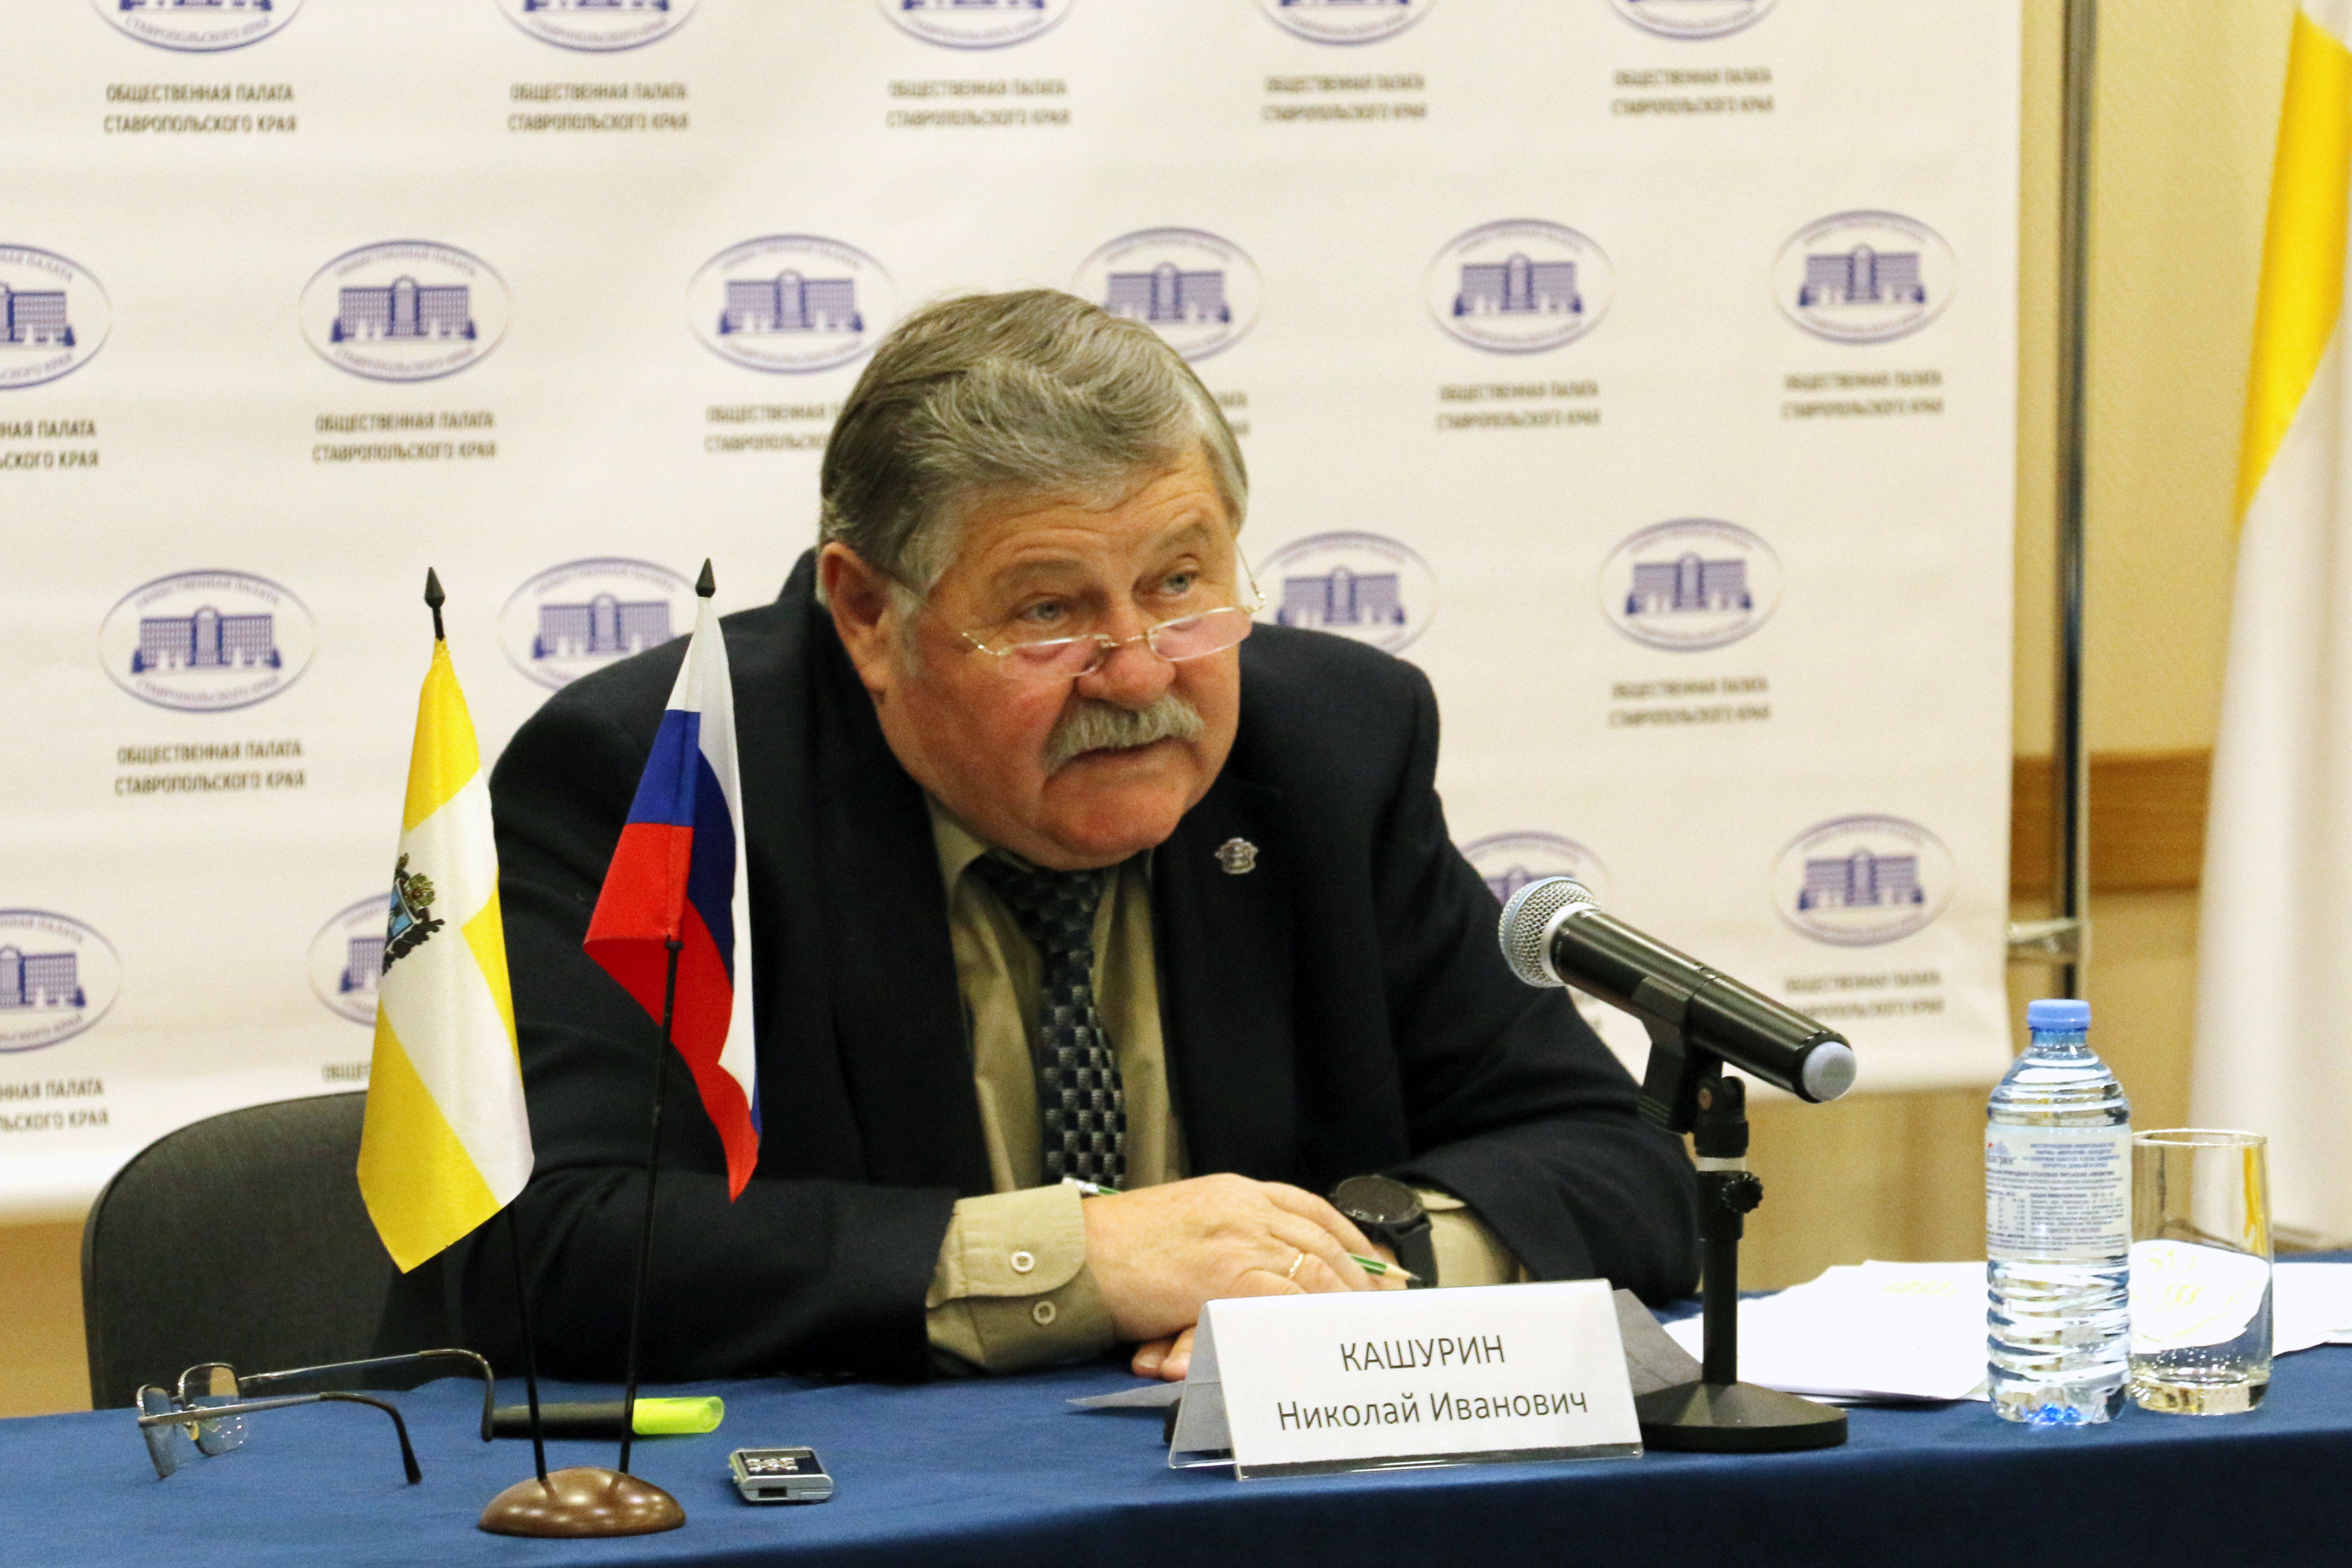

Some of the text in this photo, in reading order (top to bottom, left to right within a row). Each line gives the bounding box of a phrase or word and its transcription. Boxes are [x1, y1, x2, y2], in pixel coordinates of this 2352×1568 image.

[106, 85, 294, 102] ОБЩЕСТВЕННАЯ ПАЛАТА
[510, 82, 688, 102] ОБЩЕСТВЕННАЯ ПАЛАТА
[104, 116, 297, 132] СТАВРОПОЛЬСКОГО КРАЯ
[508, 113, 690, 132] СТАВРОПОЛЬСКОГО КРАЯ
[38, 419, 96, 438] ПАЛАТА
[315, 410, 494, 433] ОБЩЕСТВЕННАЯ ПАЛАТА
[59, 450, 99, 468] КРАЯ
[312, 441, 497, 462] СТАВРОПОЛЬСКОГО КРАЯ
[117, 740, 302, 765] ОБЩЕСТВЕННАЯ ПАЛАТА
[115, 770, 305, 796] СТАВРОПОЛЬСКОГО КРАЯ
[45, 1076, 104, 1099] ПАЛАТА
[69, 1109, 109, 1127] КРАЯ
[1341, 1335, 1504, 1371] КАШУРИН
[1278, 1391, 1588, 1430] Николай Иванович
